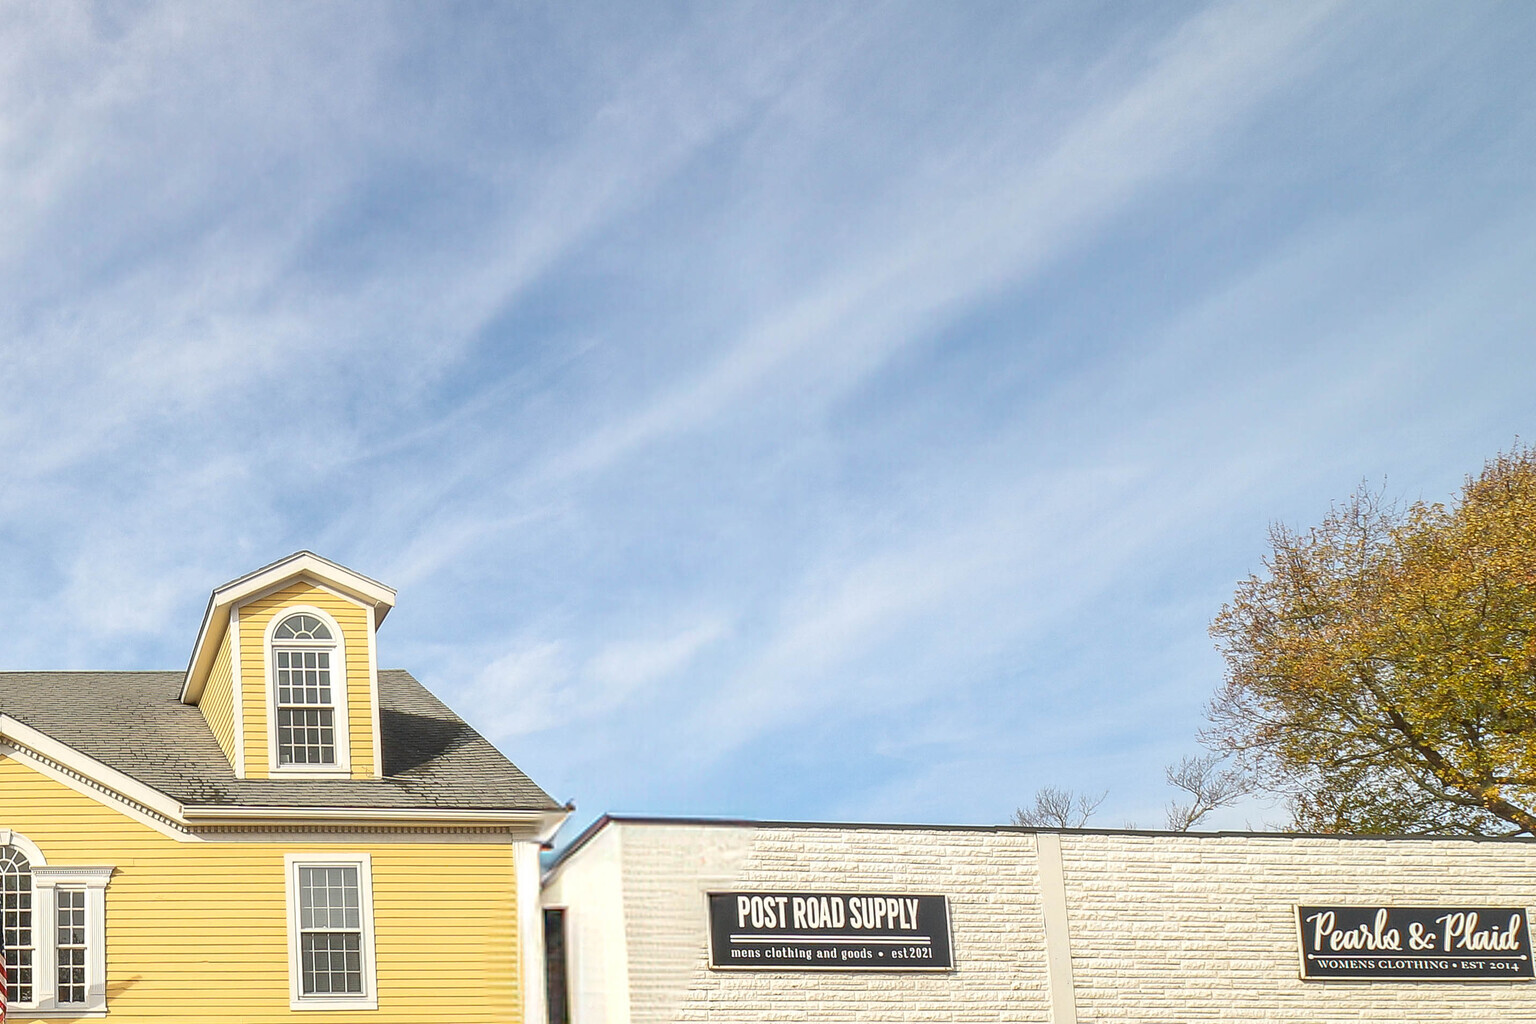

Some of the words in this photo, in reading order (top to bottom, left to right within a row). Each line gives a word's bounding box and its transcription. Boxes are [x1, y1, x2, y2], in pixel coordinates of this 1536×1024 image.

[737, 896, 788, 929] POST
[793, 897, 846, 929] ROAD
[850, 898, 919, 931] SUPPLY
[1306, 908, 1402, 952] Pearls
[1408, 922, 1437, 950] &
[1435, 911, 1522, 952] Plaid
[731, 948, 761, 959] mens
[765, 946, 812, 961] clothing
[816, 947, 837, 959] and
[841, 948, 873, 961] goods
[1317, 959, 1376, 969] WOMENS
[1377, 960, 1449, 970] CLOTHING
[1461, 961, 1486, 970] EST
[1489, 961, 1520, 972] 2014
